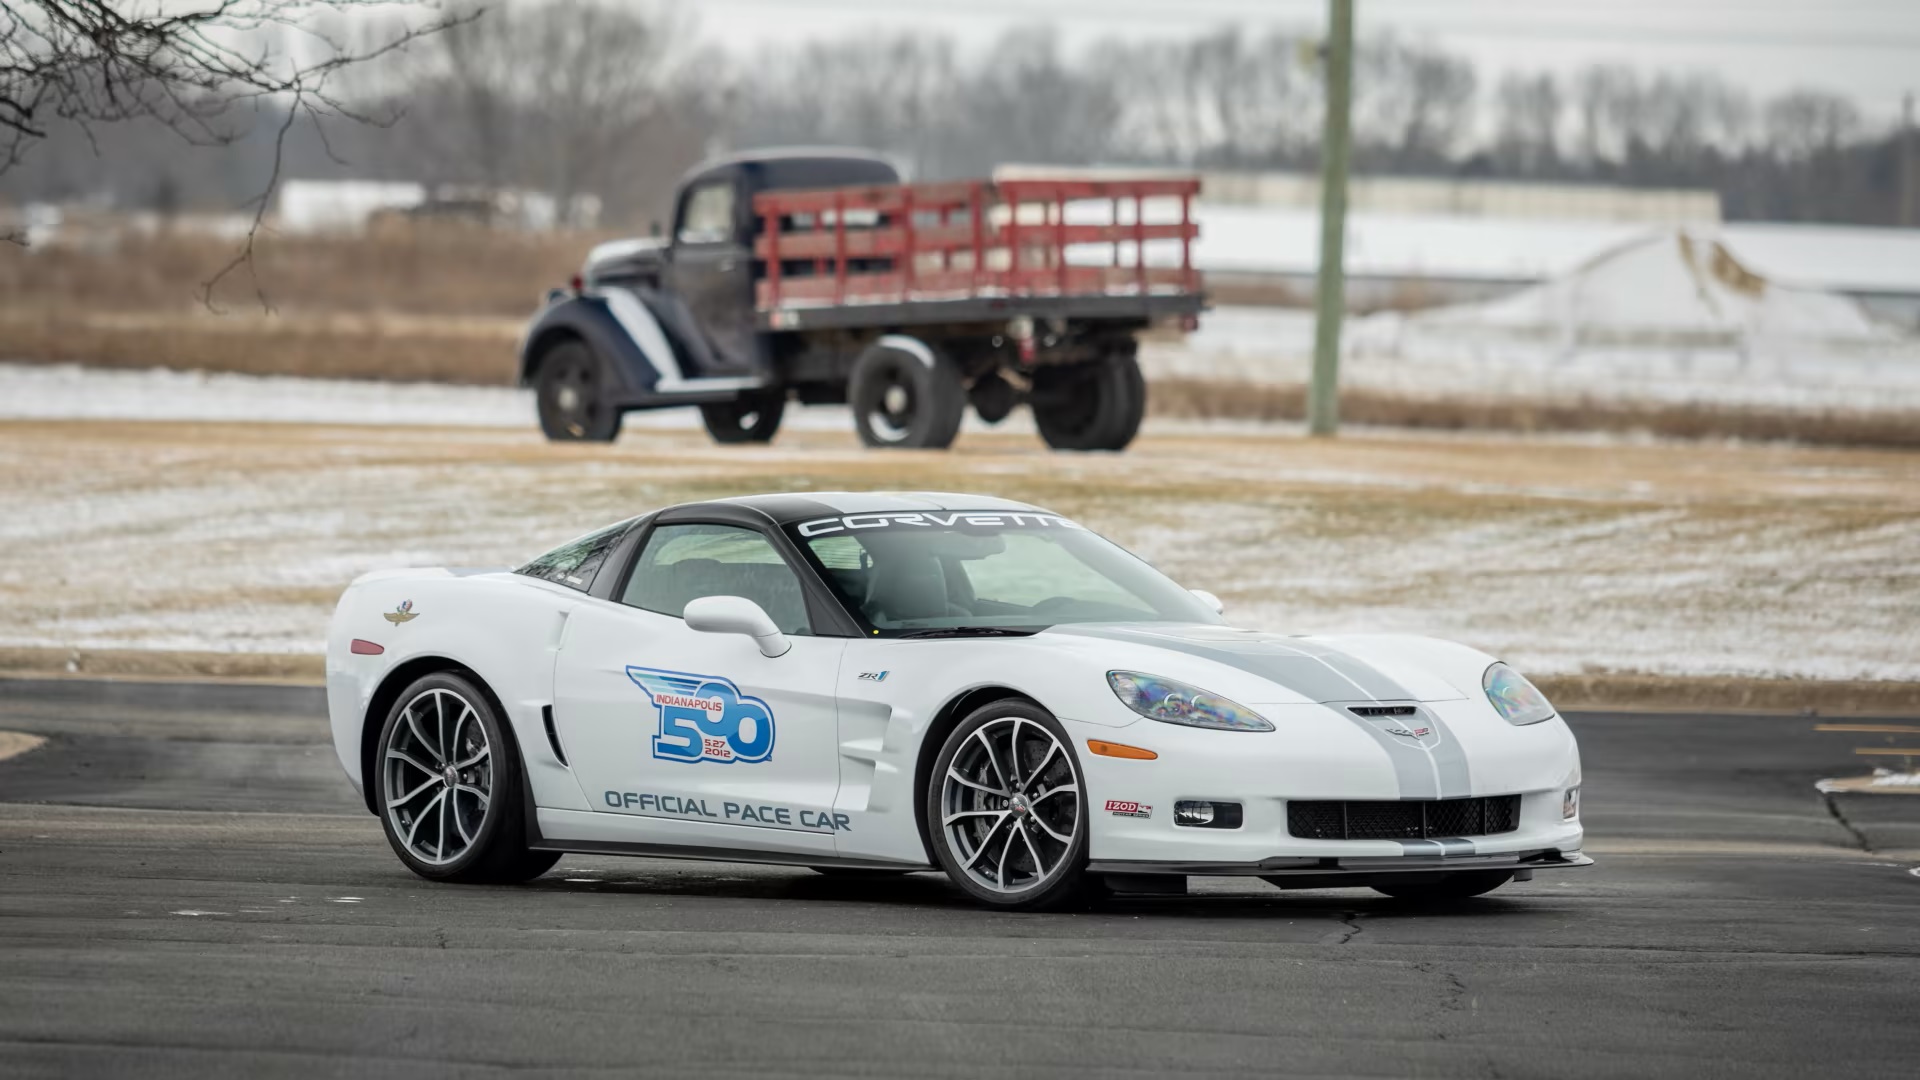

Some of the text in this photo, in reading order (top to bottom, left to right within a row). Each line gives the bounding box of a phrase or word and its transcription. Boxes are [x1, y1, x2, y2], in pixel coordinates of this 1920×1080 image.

[858, 670, 889, 681] ZR1
[656, 694, 722, 711] INDIANAPOLIS
[656, 682, 771, 757] 500
[704, 738, 726, 748] 5.27
[704, 747, 731, 758] 2012
[605, 790, 852, 832] OFFICIAL PACE CAR
[1107, 801, 1137, 811] IZOD
